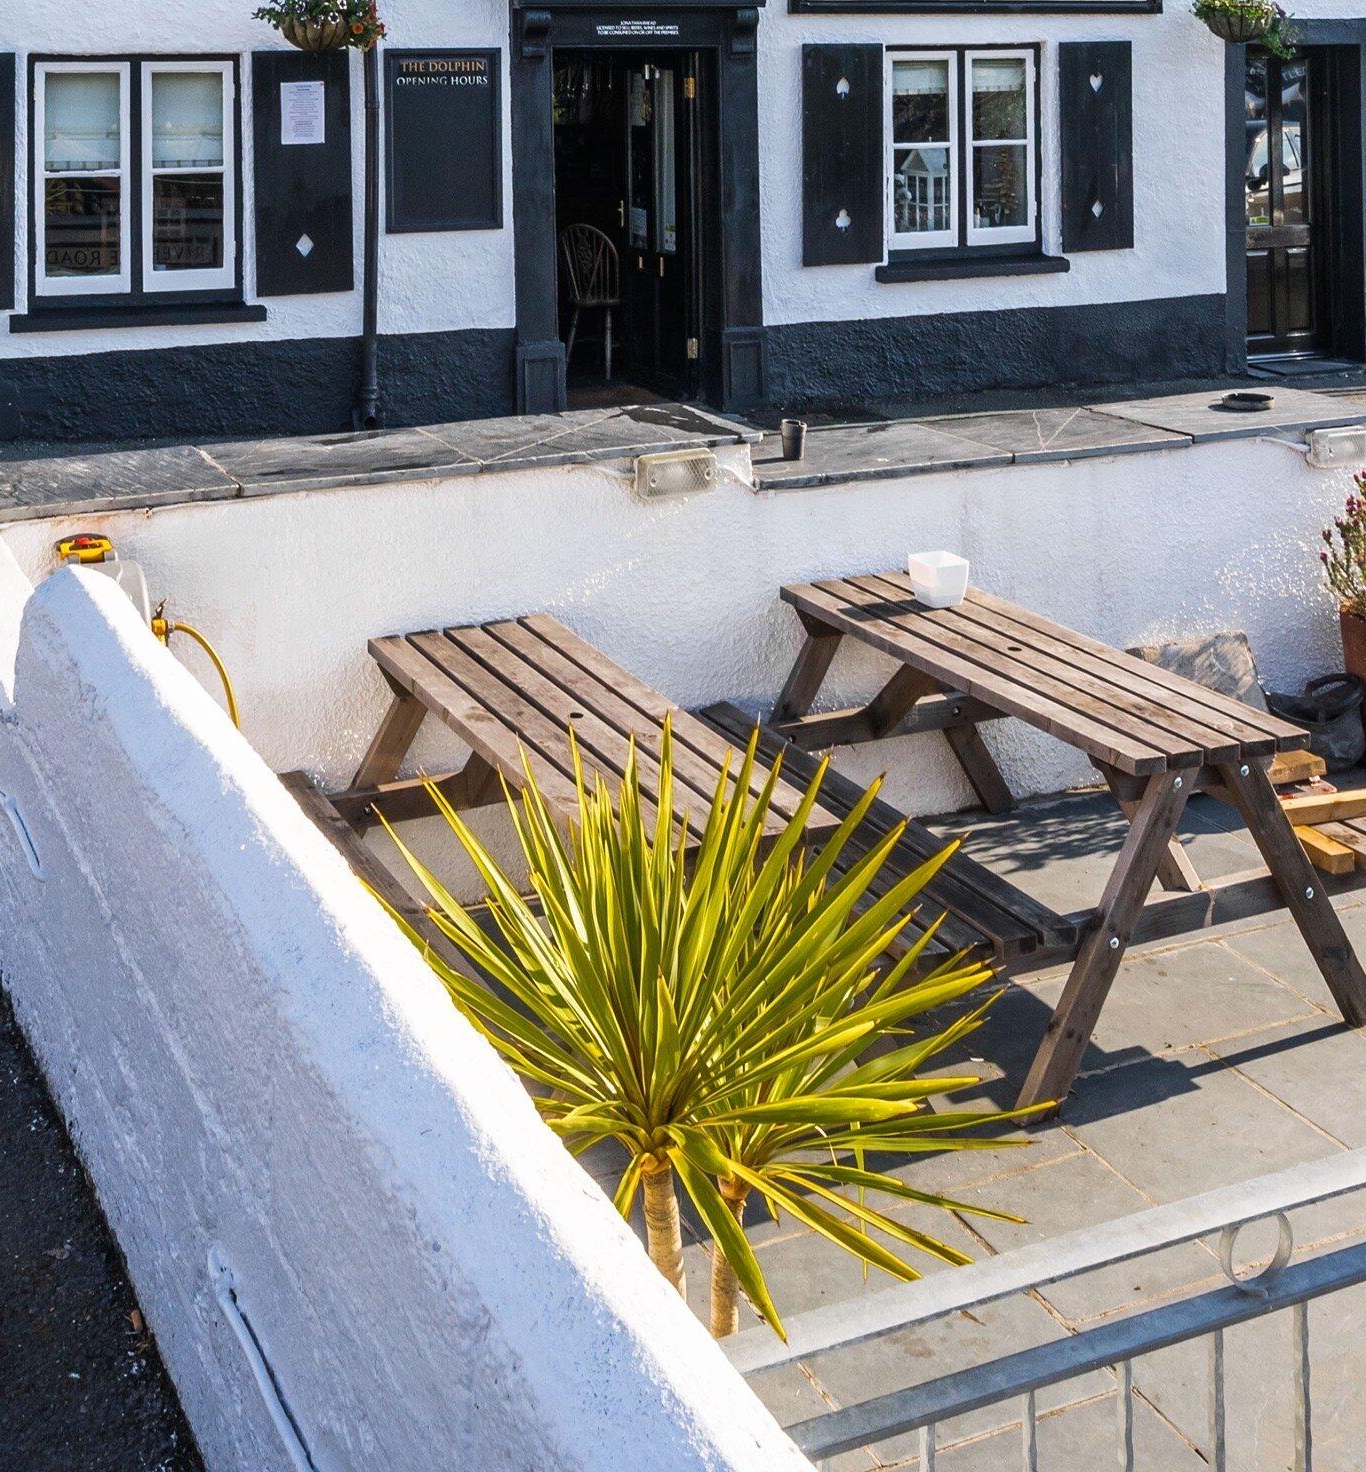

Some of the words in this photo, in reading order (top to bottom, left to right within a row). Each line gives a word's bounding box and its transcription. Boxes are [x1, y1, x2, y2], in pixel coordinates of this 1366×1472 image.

[402, 61, 426, 73] THE
[429, 60, 485, 73] DOLPHIN
[396, 76, 448, 86] OPENING
[451, 75, 488, 86] HOURS
